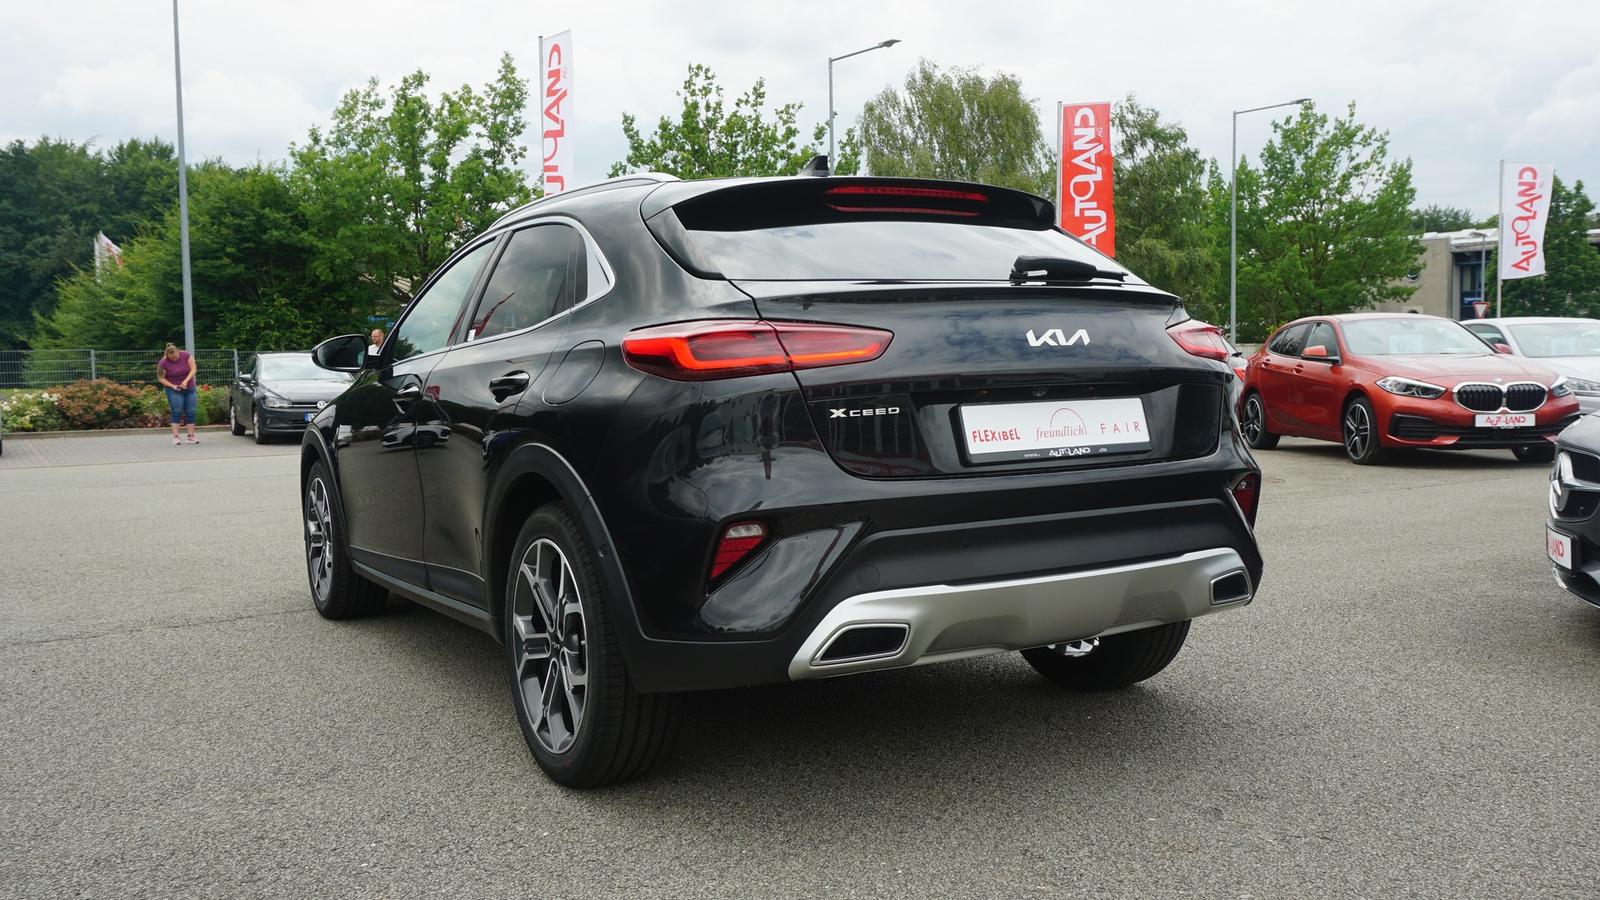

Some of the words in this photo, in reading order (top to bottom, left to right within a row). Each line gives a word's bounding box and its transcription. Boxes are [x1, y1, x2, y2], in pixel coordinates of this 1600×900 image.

[544, 43, 568, 197] UTOLAND
[1070, 107, 1107, 248] AUTOLAND
[1511, 166, 1543, 272] AUTOLAND
[1026, 329, 1091, 346] KIA
[829, 407, 900, 418] XCEED
[972, 428, 1021, 443] FLEXIBEL
[1034, 425, 1085, 442] freundlich
[1100, 421, 1141, 435] FAIR
[1049, 446, 1091, 457] AUTOLAND
